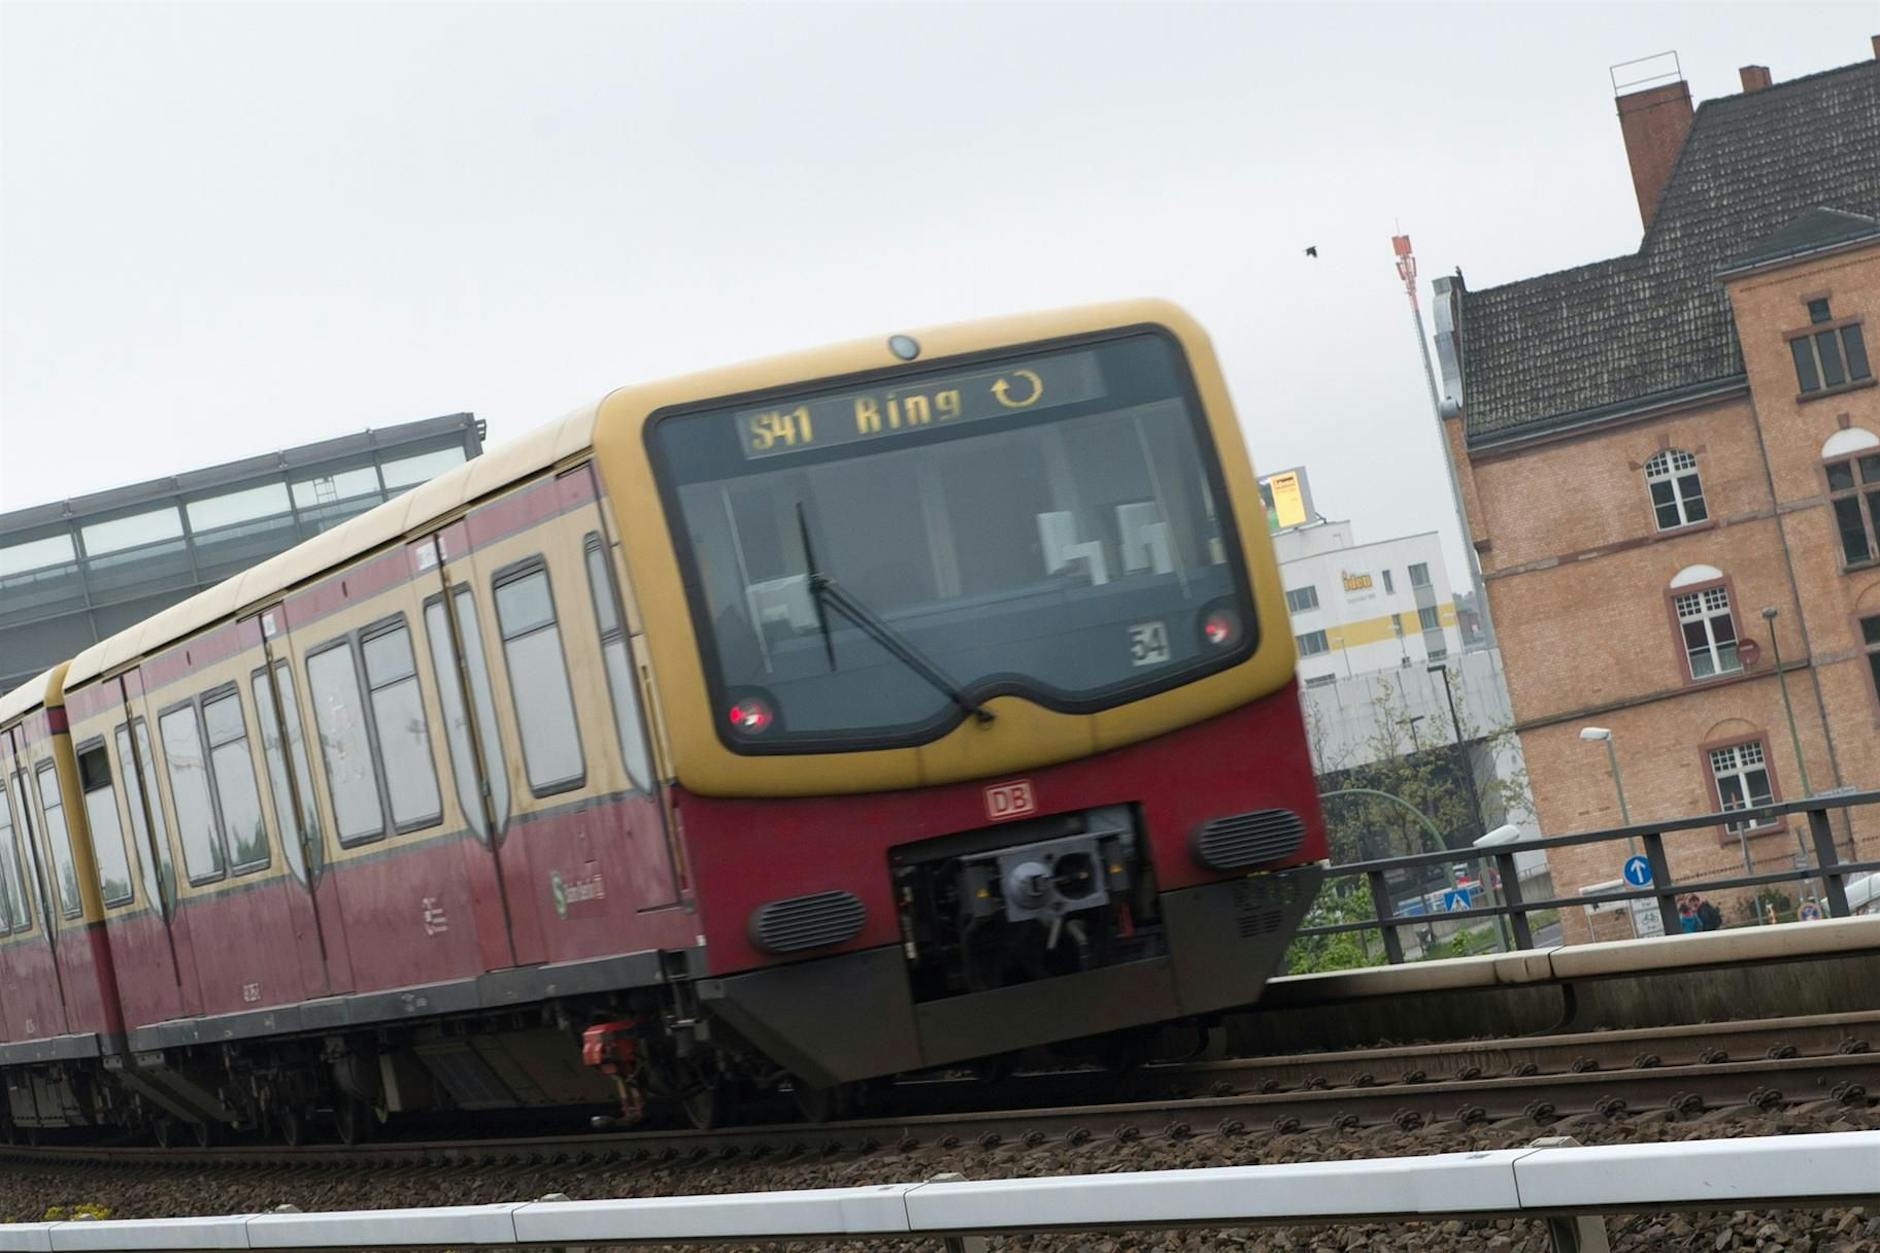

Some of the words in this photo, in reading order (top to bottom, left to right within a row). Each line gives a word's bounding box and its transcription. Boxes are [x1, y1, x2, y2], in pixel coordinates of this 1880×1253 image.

[751, 406, 814, 449] S41
[854, 389, 961, 434] Ring
[1129, 627, 1167, 661] 54
[992, 786, 1027, 814] DB
